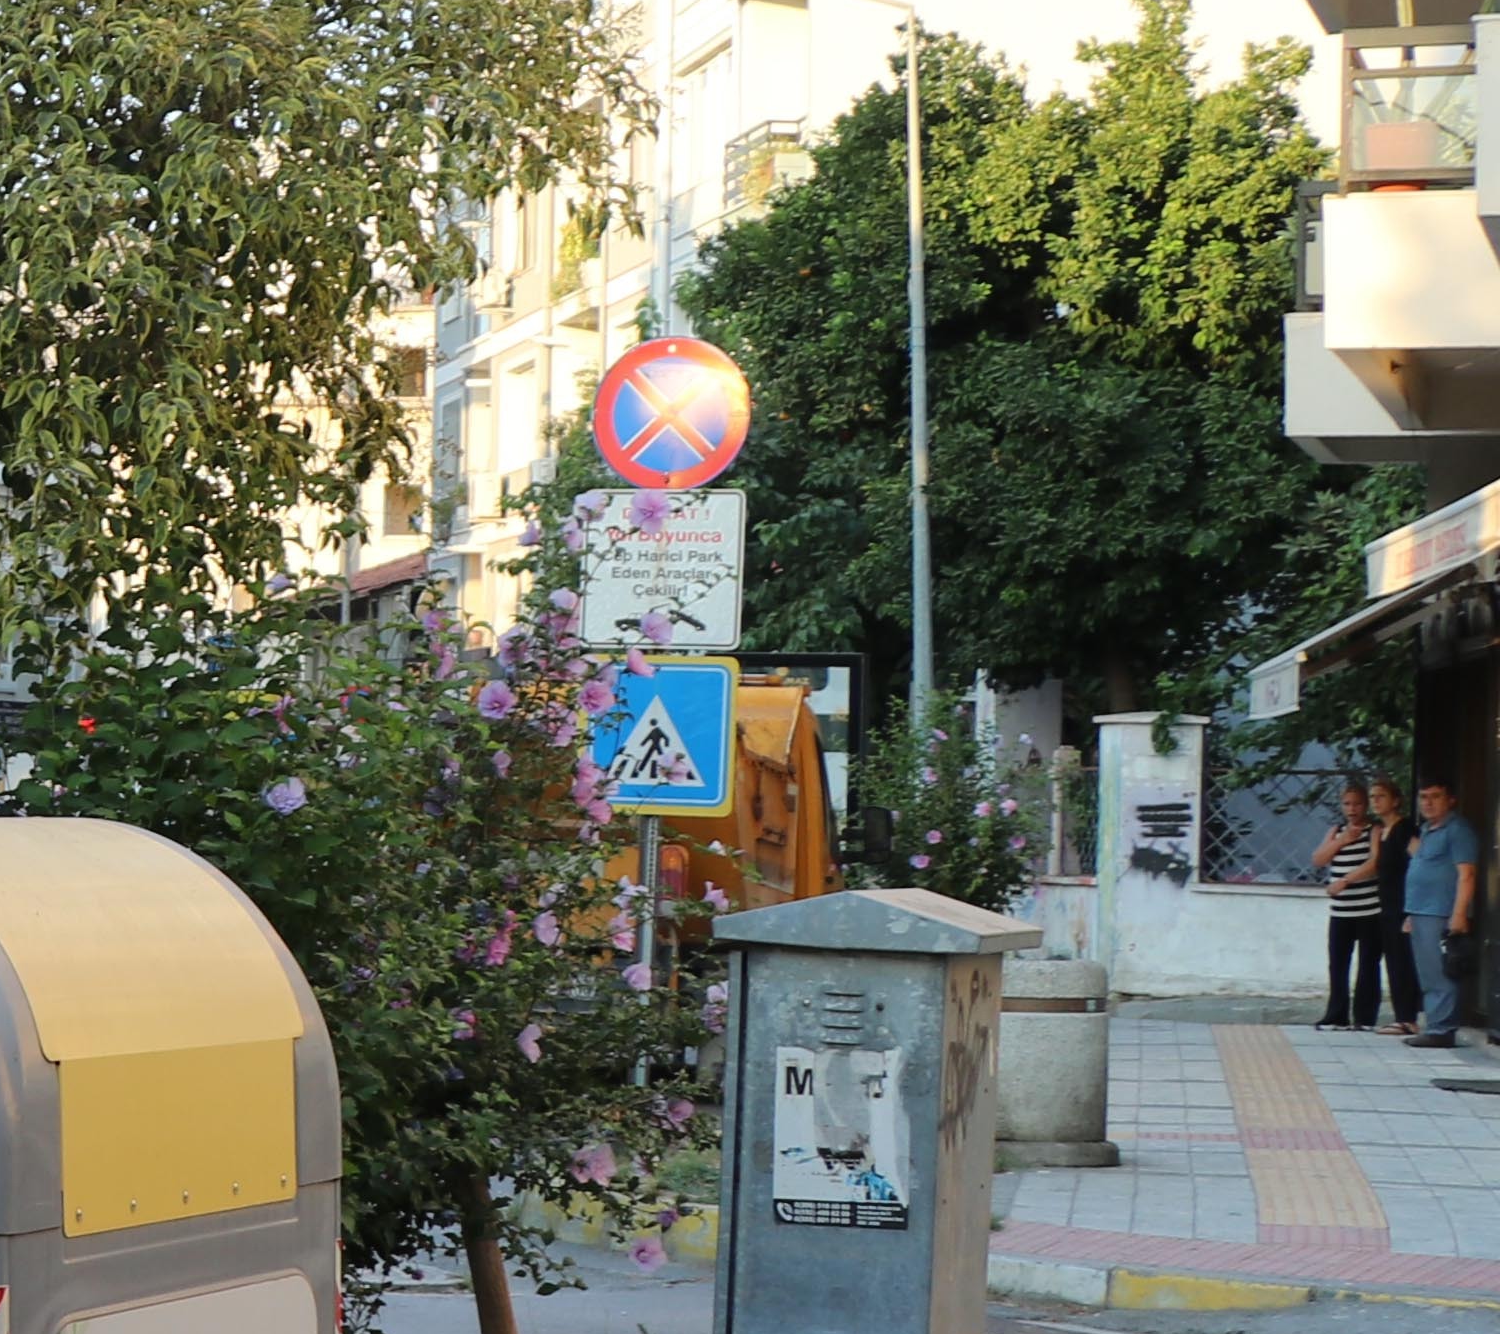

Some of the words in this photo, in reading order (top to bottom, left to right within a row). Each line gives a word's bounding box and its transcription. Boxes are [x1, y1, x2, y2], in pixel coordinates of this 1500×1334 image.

[638, 529, 722, 546] Boyunca
[687, 550, 723, 563] Park
[612, 567, 651, 579] Eden
[655, 567, 710, 582] Araçlar
